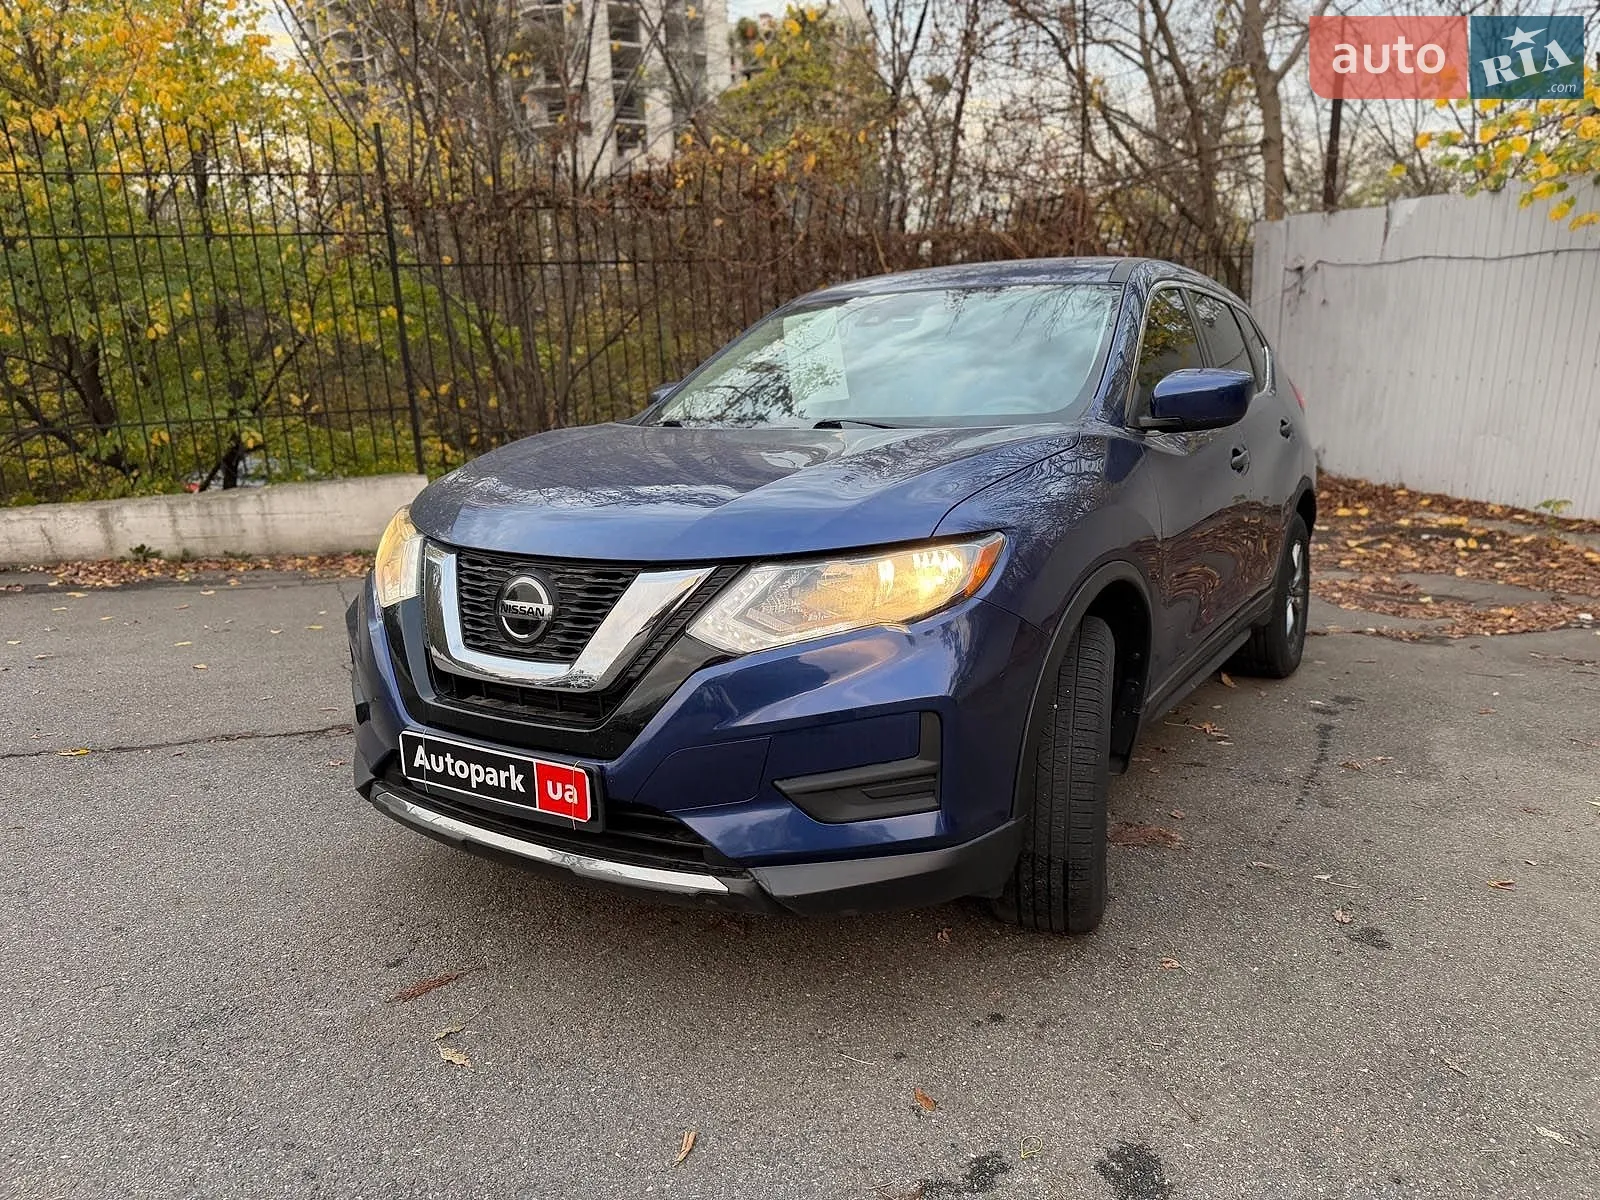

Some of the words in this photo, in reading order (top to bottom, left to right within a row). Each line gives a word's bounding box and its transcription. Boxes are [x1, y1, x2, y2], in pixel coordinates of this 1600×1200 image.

[500, 603, 545, 617] NISSAN
[413, 745, 526, 793] Autopark
[546, 779, 579, 804] ua
